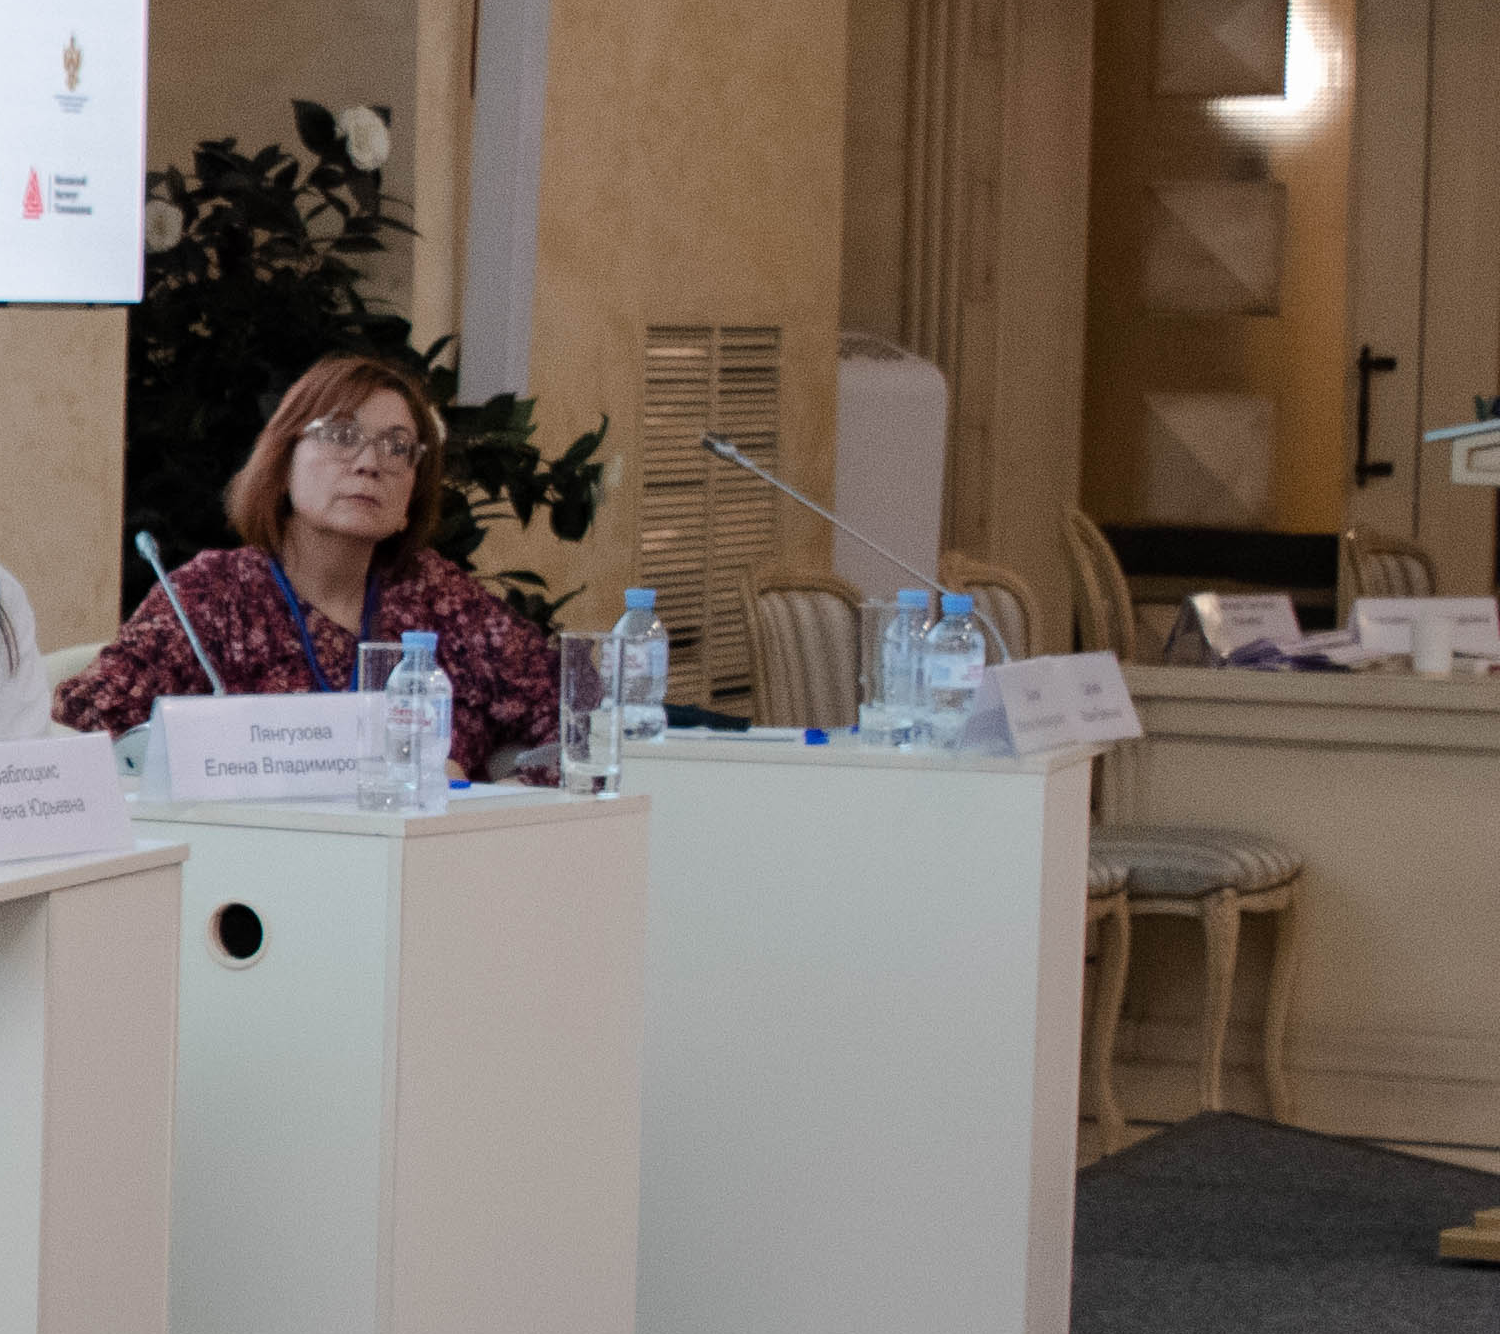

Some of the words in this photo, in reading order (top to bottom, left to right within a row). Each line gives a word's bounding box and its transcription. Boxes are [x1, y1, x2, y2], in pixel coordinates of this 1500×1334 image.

[250, 724, 332, 746] Лянгузова
[205, 758, 257, 777] Елена
[262, 756, 358, 776] Владимиро
